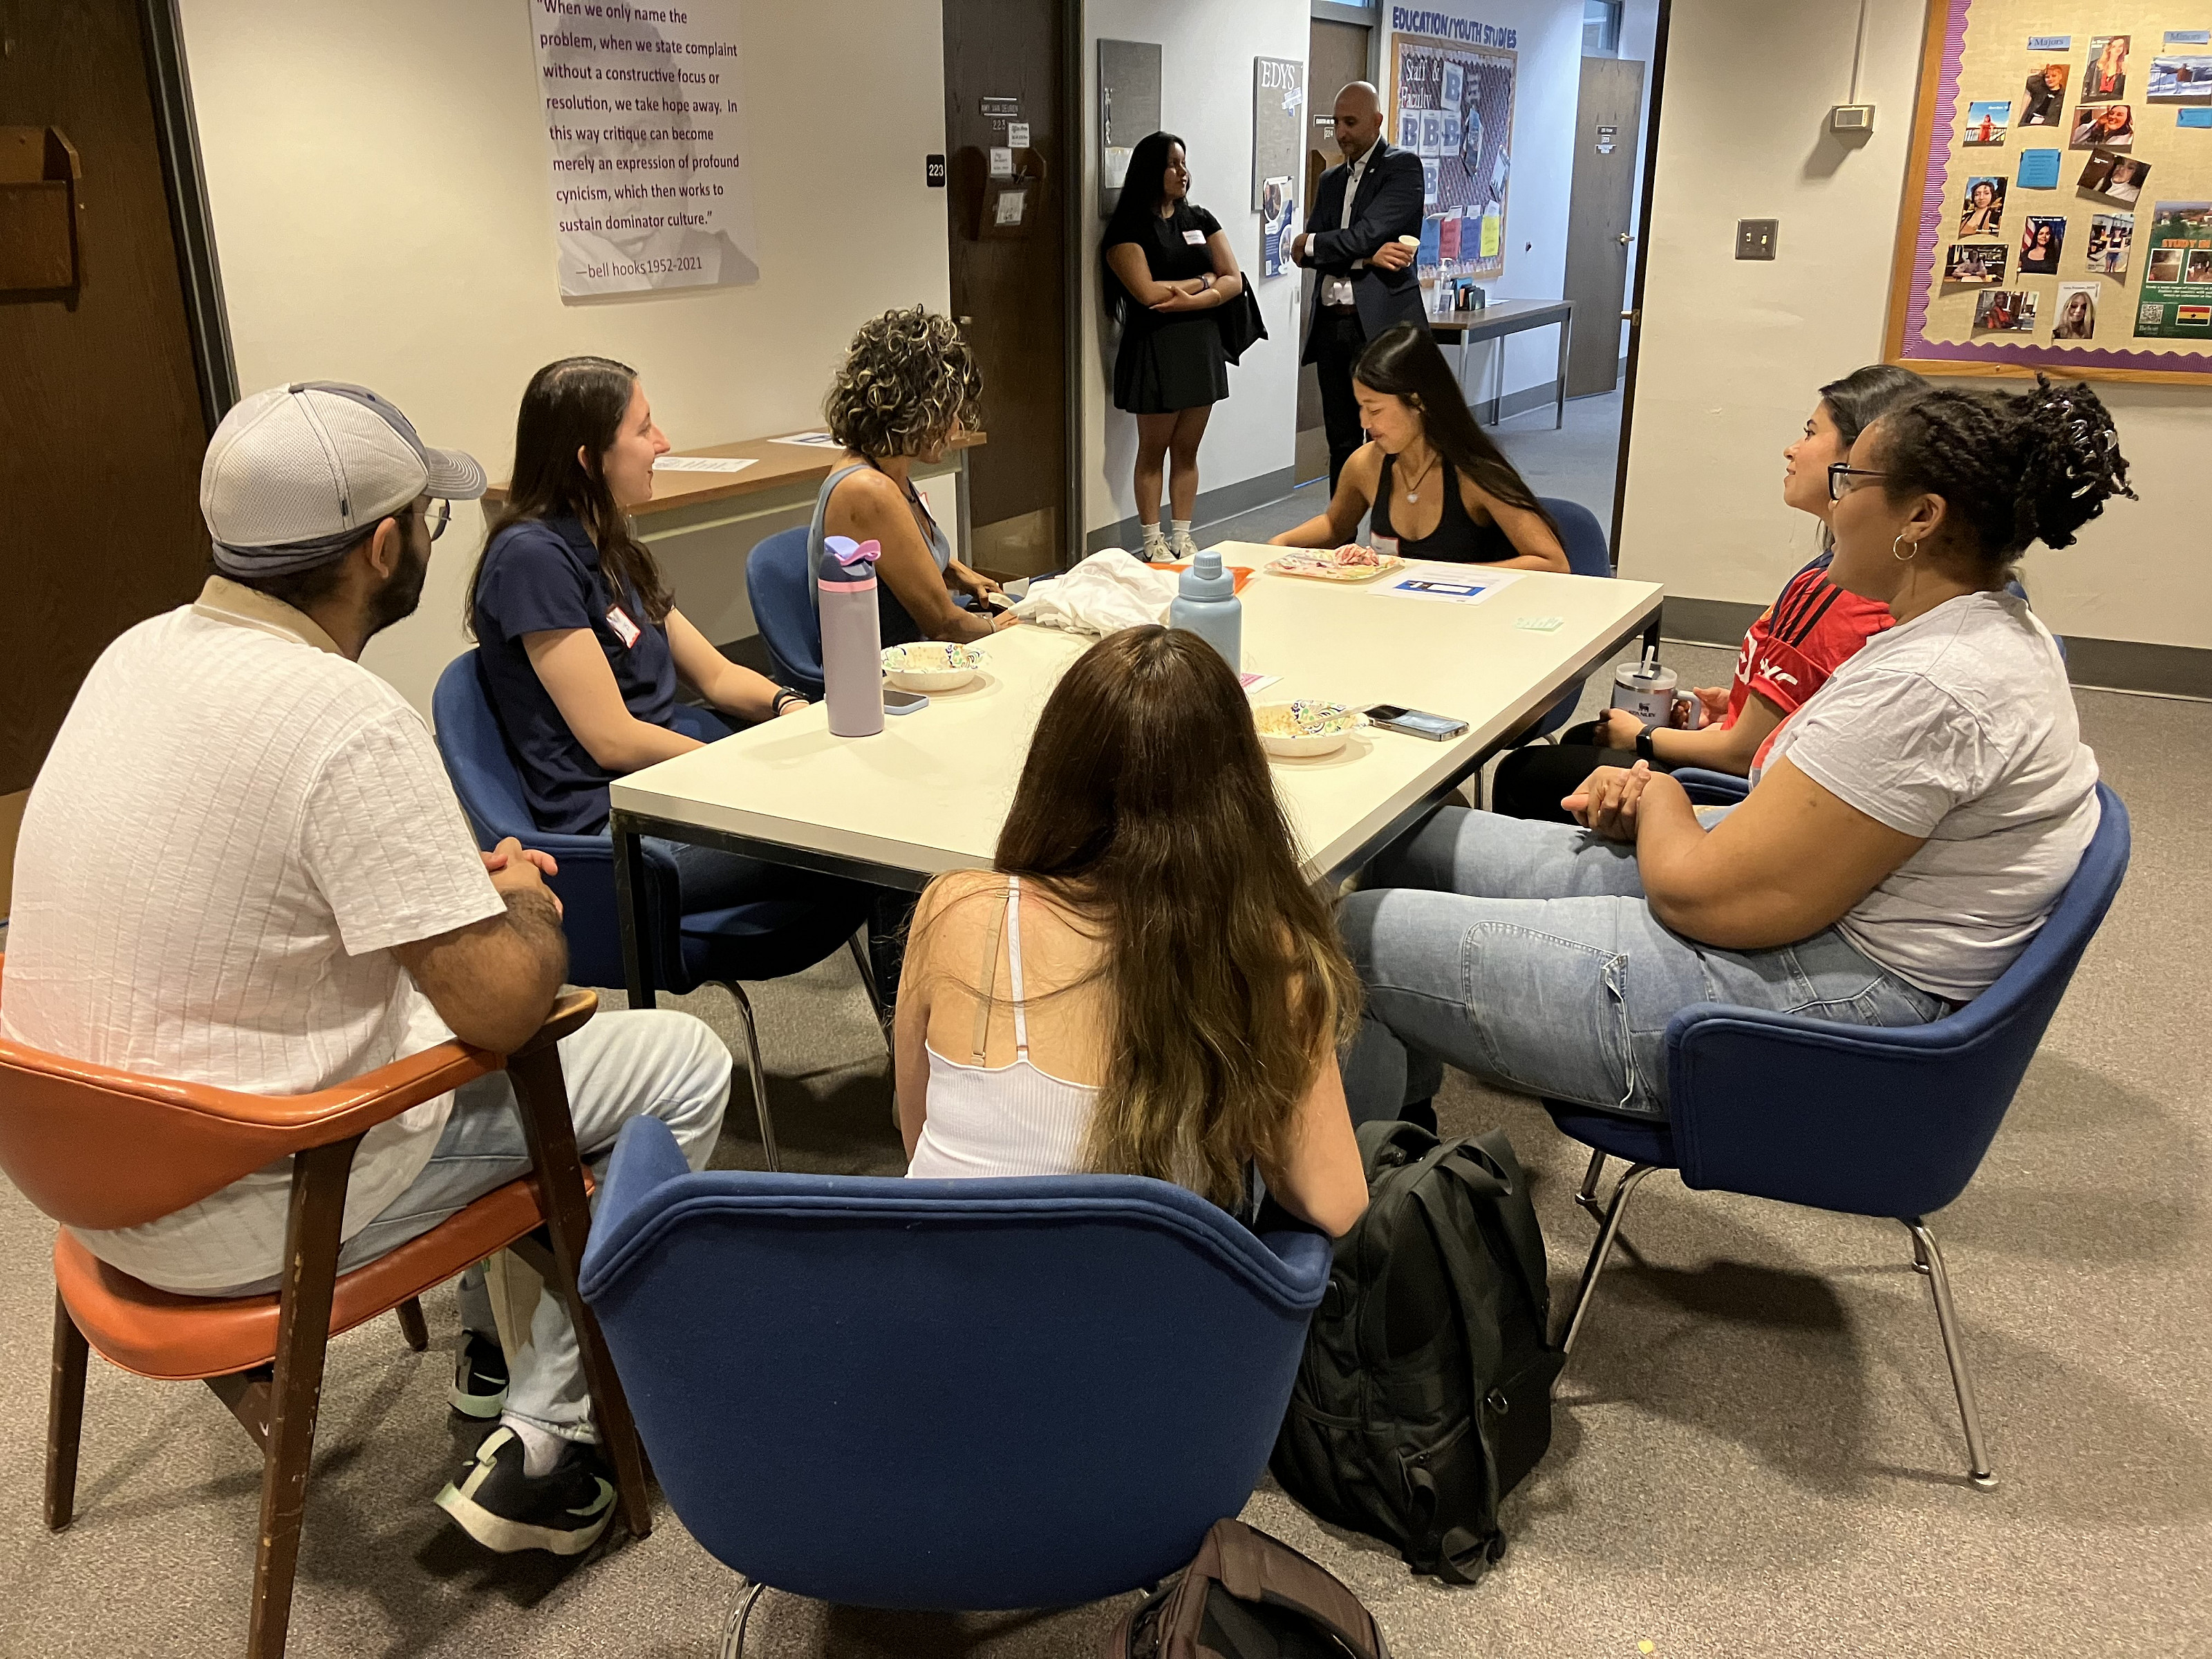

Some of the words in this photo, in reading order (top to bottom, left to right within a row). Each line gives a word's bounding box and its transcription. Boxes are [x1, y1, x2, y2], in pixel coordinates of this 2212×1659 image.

[585, 5, 602, 17] we
[606, 4, 630, 22] only
[635, 10, 666, 22] name
[669, 8, 686, 24] the
[541, 32, 596, 50] problem,
[600, 35, 632, 50] when
[636, 41, 652, 52] we
[656, 40, 682, 53] state
[686, 42, 737, 59] complaint
[1484, 25, 1517, 48] STUDIES
[2034, 38, 2063, 47] Majors
[543, 64, 592, 79] without
[596, 70, 602, 79] a
[606, 68, 674, 82] constructive
[678, 71, 705, 84] focus
[709, 74, 719, 84] or
[1262, 60, 1295, 91] EDYS
[1406, 59, 1427, 81] Staff
[1432, 60, 1440, 81] &
[547, 95, 611, 113] resolution,
[615, 100, 632, 111] we
[635, 98, 659, 111] take
[662, 98, 689, 115] hope
[693, 102, 722, 115] away.
[728, 100, 737, 113] In
[1400, 86, 1432, 109] Faculty
[550, 125, 572, 140] this
[576, 129, 599, 144] way
[603, 126, 646, 144] critique
[650, 130, 668, 140] can
[672, 126, 713, 140] become
[1402, 118, 1418, 146] B
[1423, 118, 1439, 146] B
[1444, 118, 1459, 146] B
[553, 155, 594, 174] merely
[599, 160, 612, 171] an
[617, 155, 675, 174] expression
[679, 153, 688, 169] of
[693, 153, 739, 171] profound
[929, 164, 944, 176] 223
[556, 185, 611, 205] cynicism,
[615, 184, 648, 199] which
[651, 184, 675, 198] then
[679, 182, 710, 198] works
[713, 184, 723, 196] to
[560, 218, 602, 234] sustain
[606, 214, 664, 229] dominator
[612, 260, 646, 276] hooks
[646, 257, 702, 274] 1952-2021
